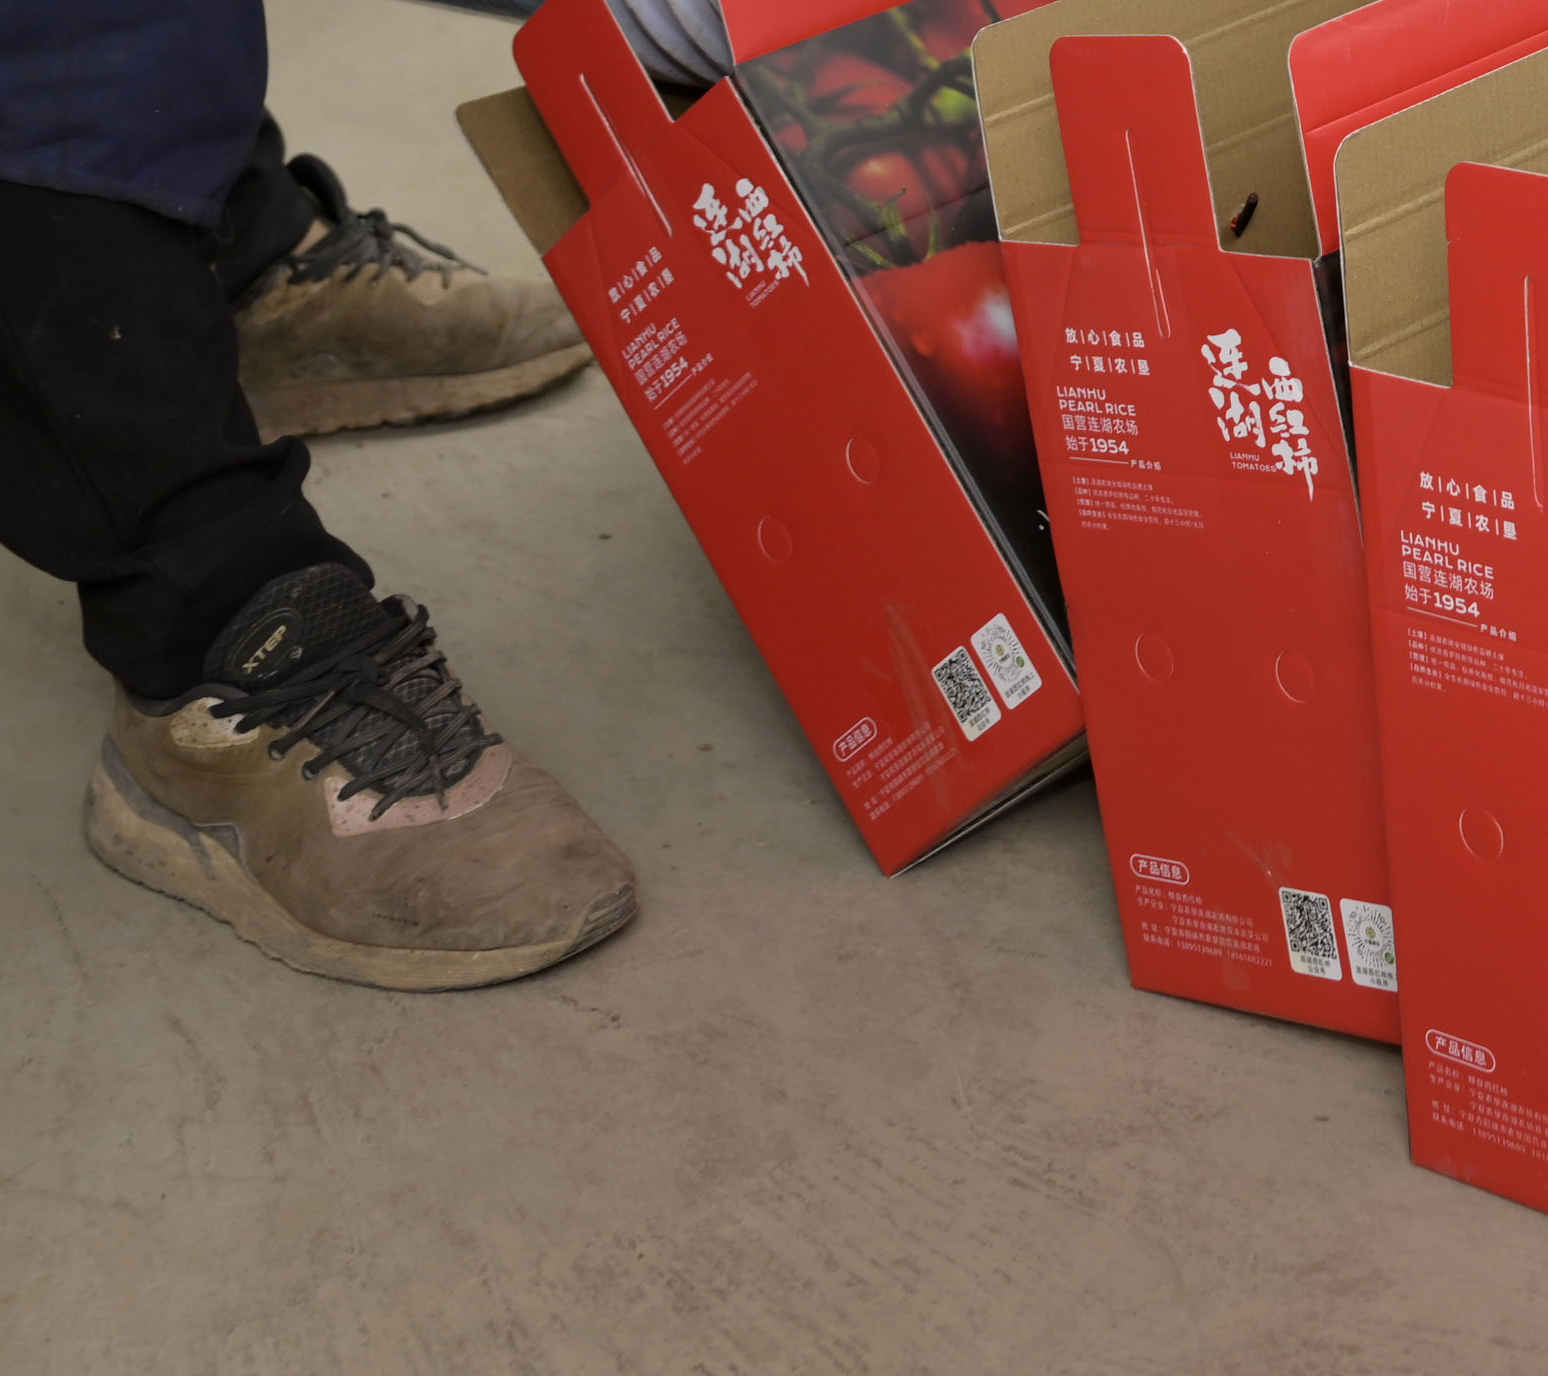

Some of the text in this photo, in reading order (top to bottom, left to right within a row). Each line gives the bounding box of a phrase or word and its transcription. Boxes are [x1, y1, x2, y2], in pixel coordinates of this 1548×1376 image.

[1056, 385, 1106, 400] LIANHU
[1059, 399, 1136, 416] PEARL RICE
[1061, 414, 1138, 436] 国营连湖农场
[1065, 435, 1130, 455] 始于1954
[1229, 451, 1260, 462] LIANHU
[1400, 529, 1460, 556] LIANHU
[1402, 545, 1495, 580] PEARL RICE
[1403, 560, 1495, 600] 国营连湖农场
[1404, 583, 1480, 618] 始于1954
[242, 625, 286, 674] XTEP
[838, 723, 873, 757] 产品信息
[1138, 859, 1182, 880] 产品信息
[1435, 1036, 1487, 1067] 产品信息
